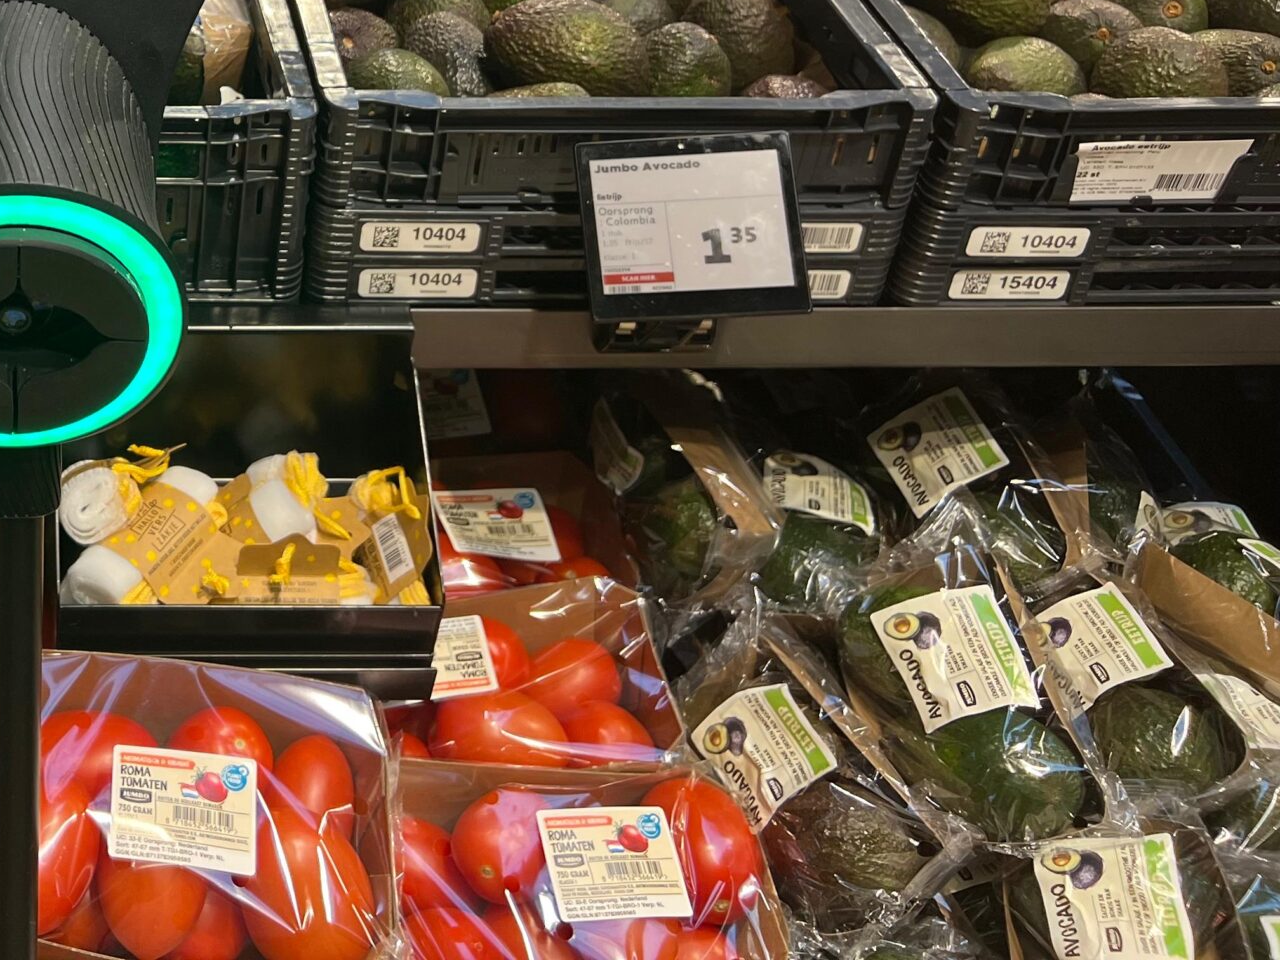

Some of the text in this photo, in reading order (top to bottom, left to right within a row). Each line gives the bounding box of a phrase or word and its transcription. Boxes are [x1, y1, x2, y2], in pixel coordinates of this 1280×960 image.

[1091, 144, 1135, 152] Avocado
[594, 160, 700, 174] Jumbo Avocado
[598, 207, 653, 216] Oorsprong
[605, 216, 656, 226] Colombia
[413, 227, 466, 241] 10404
[1021, 235, 1078, 248] 10404
[409, 273, 462, 286] 10404
[1000, 276, 1058, 289] 15404
[891, 454, 930, 506] AVOCADO
[136, 508, 159, 531] HALLO
[146, 514, 169, 536] VERS
[155, 521, 179, 544] ZAKJE
[1112, 607, 1144, 646] EETRIJP
[443, 660, 483, 671] TOMATEN
[460, 668, 486, 678] ROMA
[898, 646, 942, 721] AVOCADO
[778, 702, 814, 754] EETRIJP
[120, 764, 151, 777] ROMA
[121, 776, 168, 791] TOMATEN
[122, 790, 150, 799] JUMBO
[118, 803, 153, 816] 750 GRAM
[548, 830, 577, 841] ROMA
[551, 840, 596, 853] TOMATEN
[1050, 882, 1081, 958] AVOCADO
